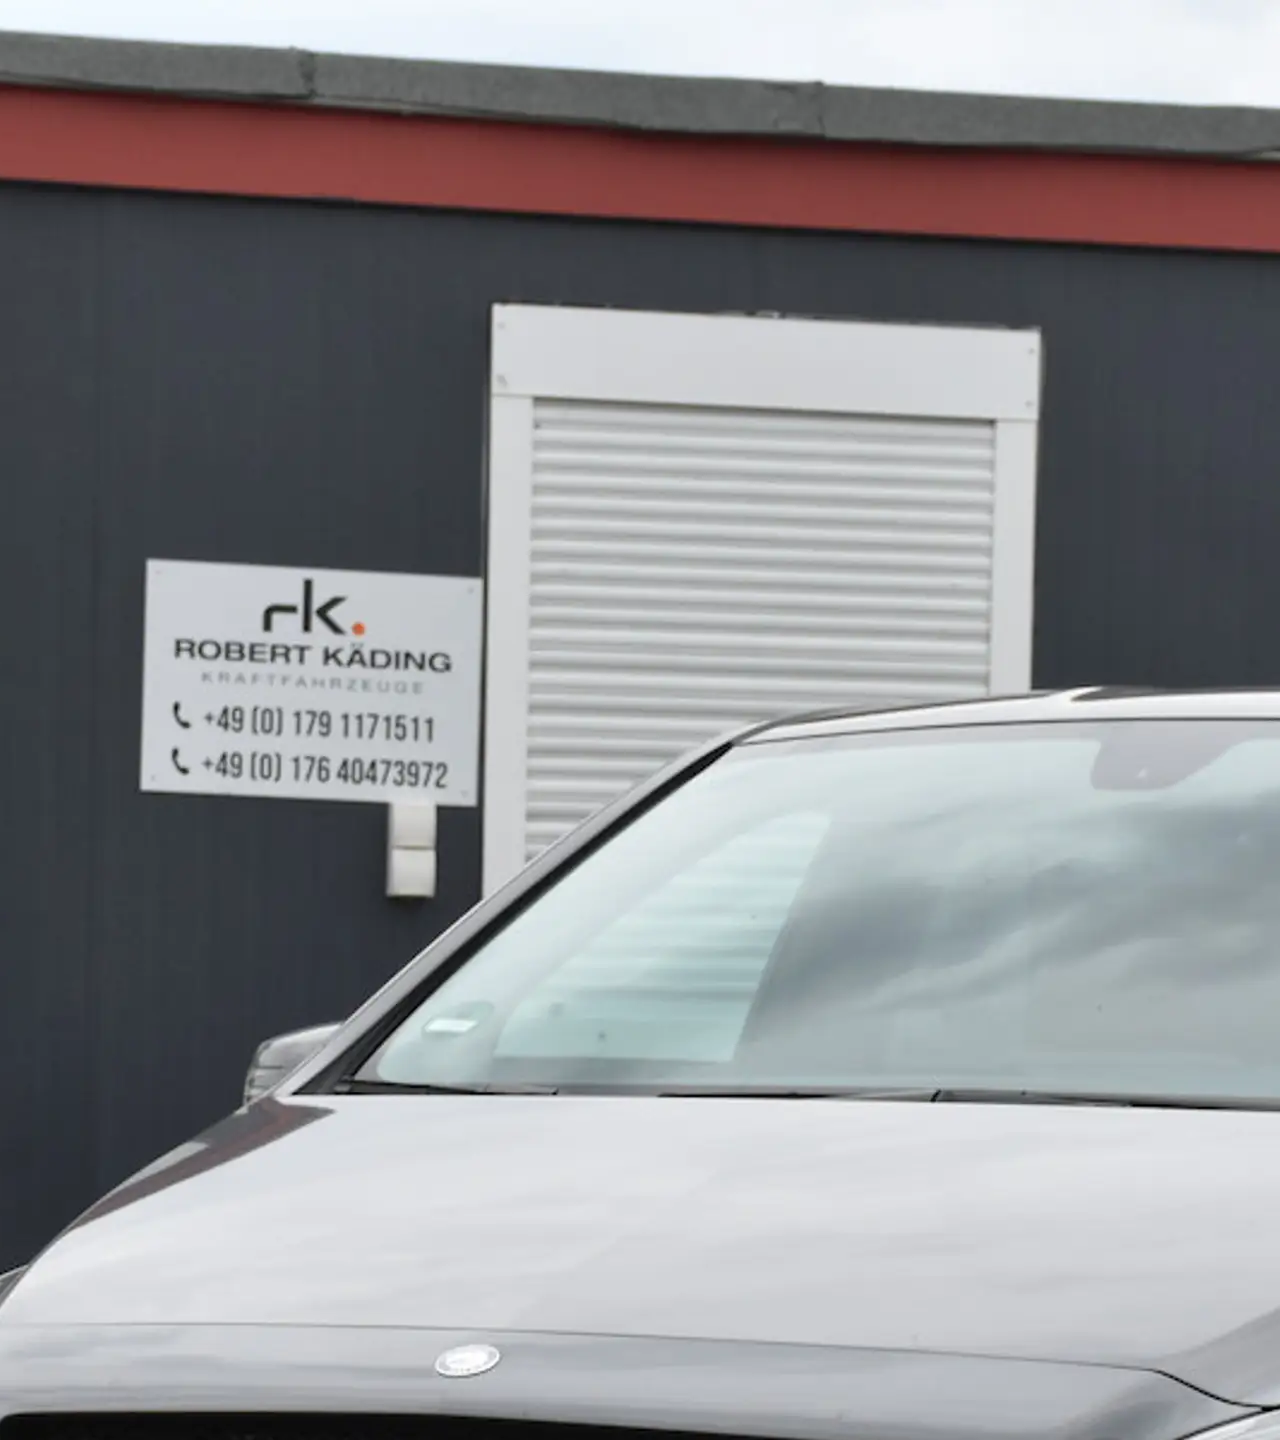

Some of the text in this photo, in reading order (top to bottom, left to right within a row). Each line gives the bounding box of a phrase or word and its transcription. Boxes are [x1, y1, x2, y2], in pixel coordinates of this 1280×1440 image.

[174, 637, 453, 674] ROBERT KÄDING
[200, 671, 424, 695] KRAFTFAHRZEUGE
[204, 704, 434, 743] +49 (0) 179 1171511
[202, 751, 448, 789] +49 (0) 176 40473972
